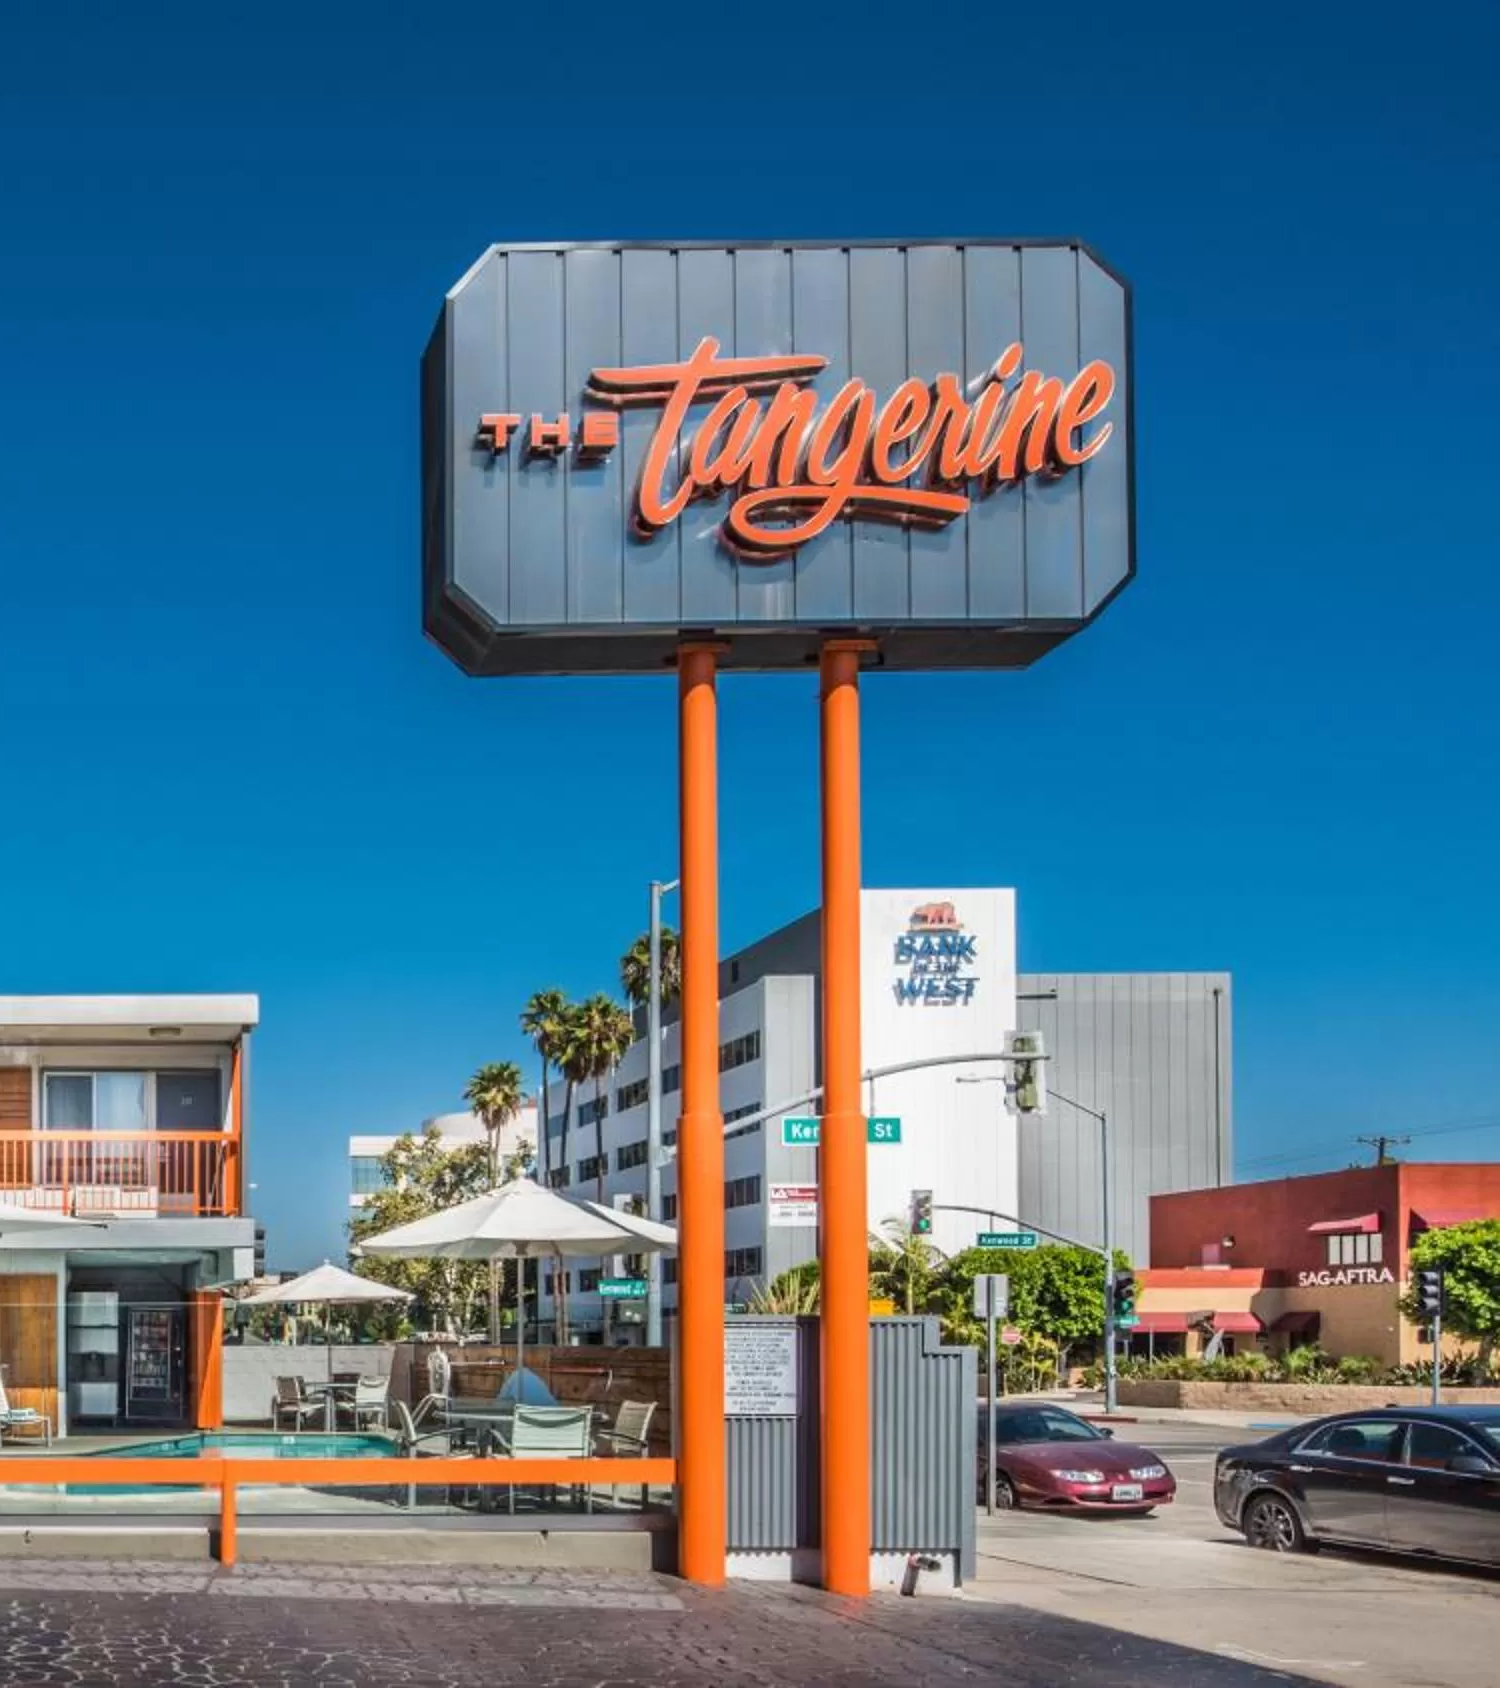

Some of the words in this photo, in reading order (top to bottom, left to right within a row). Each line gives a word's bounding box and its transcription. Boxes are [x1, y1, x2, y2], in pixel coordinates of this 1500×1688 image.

[480, 412, 620, 450] THE
[895, 934, 977, 960] BANK
[894, 977, 980, 1001] WEST
[874, 1123, 893, 1138] St
[1298, 1267, 1394, 1287] SAG-AFTRA
